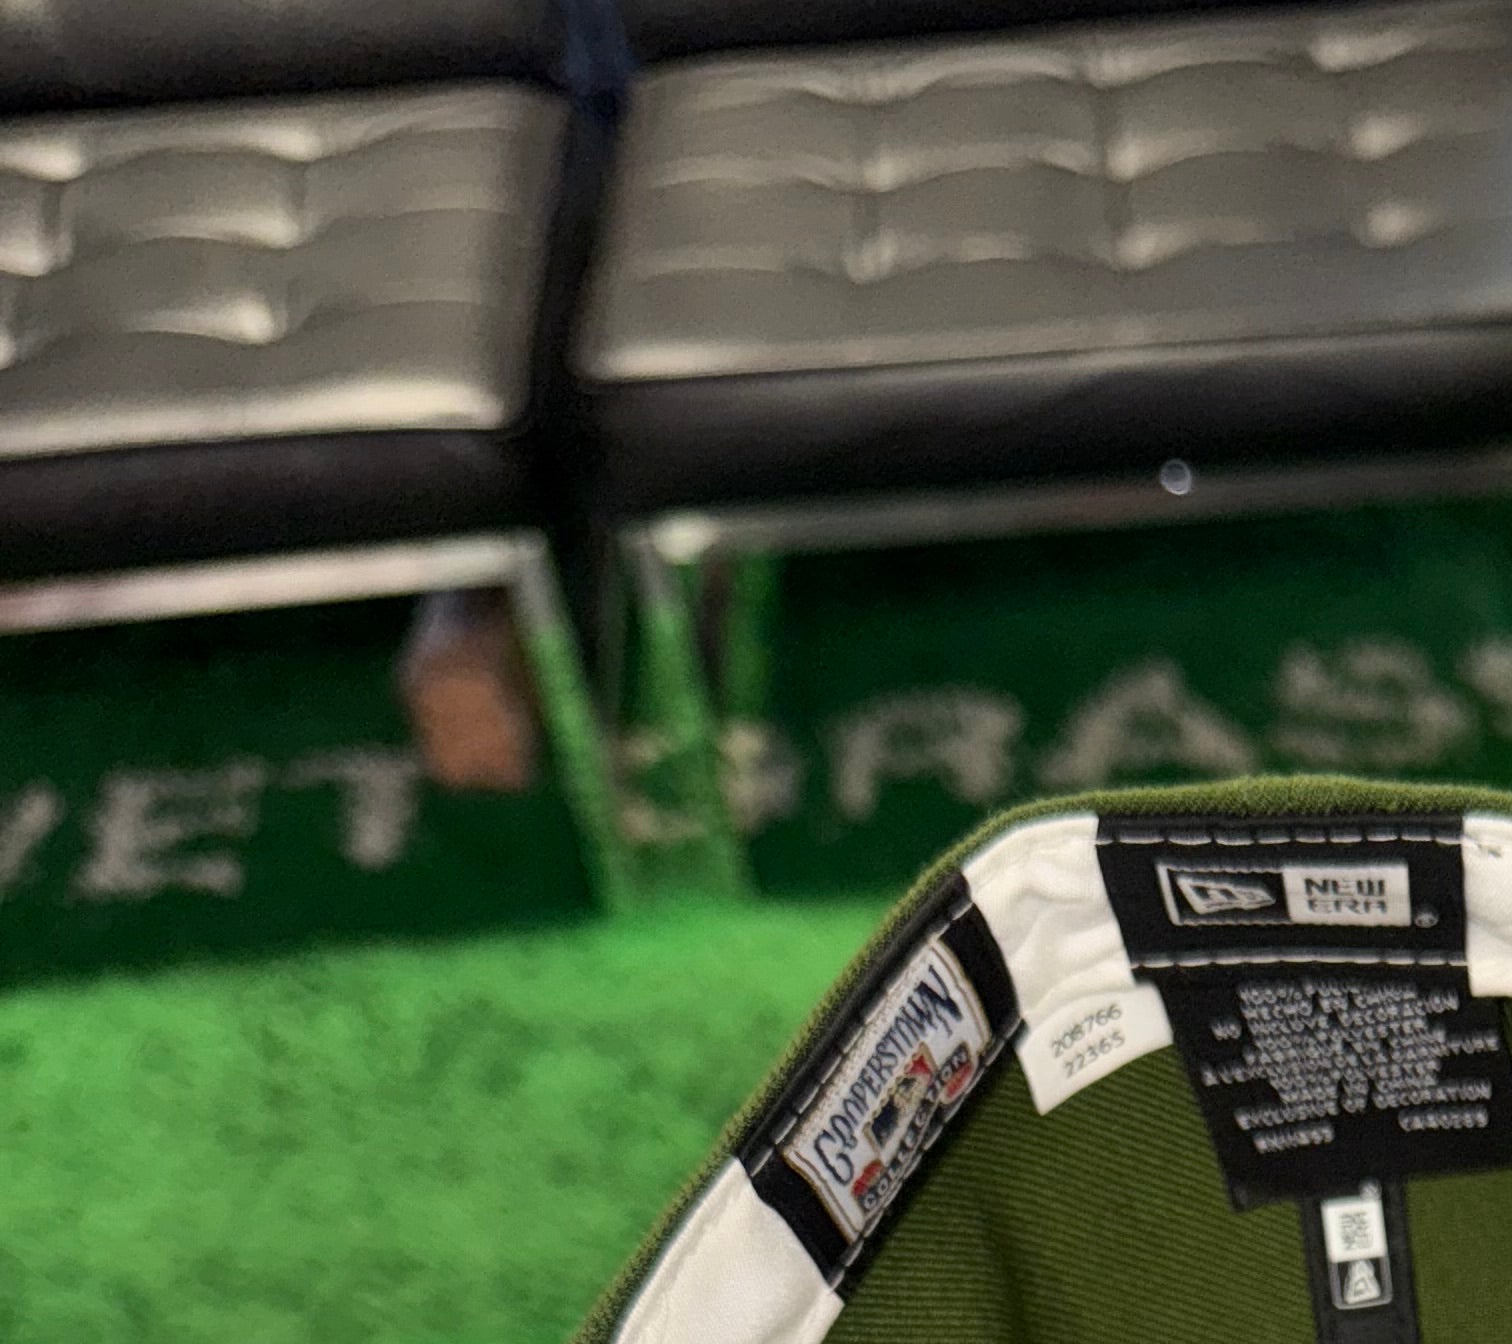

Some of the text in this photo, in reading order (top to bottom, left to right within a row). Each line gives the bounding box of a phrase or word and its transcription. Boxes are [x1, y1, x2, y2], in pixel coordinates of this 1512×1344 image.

[1303, 876, 1386, 898] NEW
[1306, 898, 1388, 915] ERA
[814, 964, 963, 1187] COOPERSTOWN
